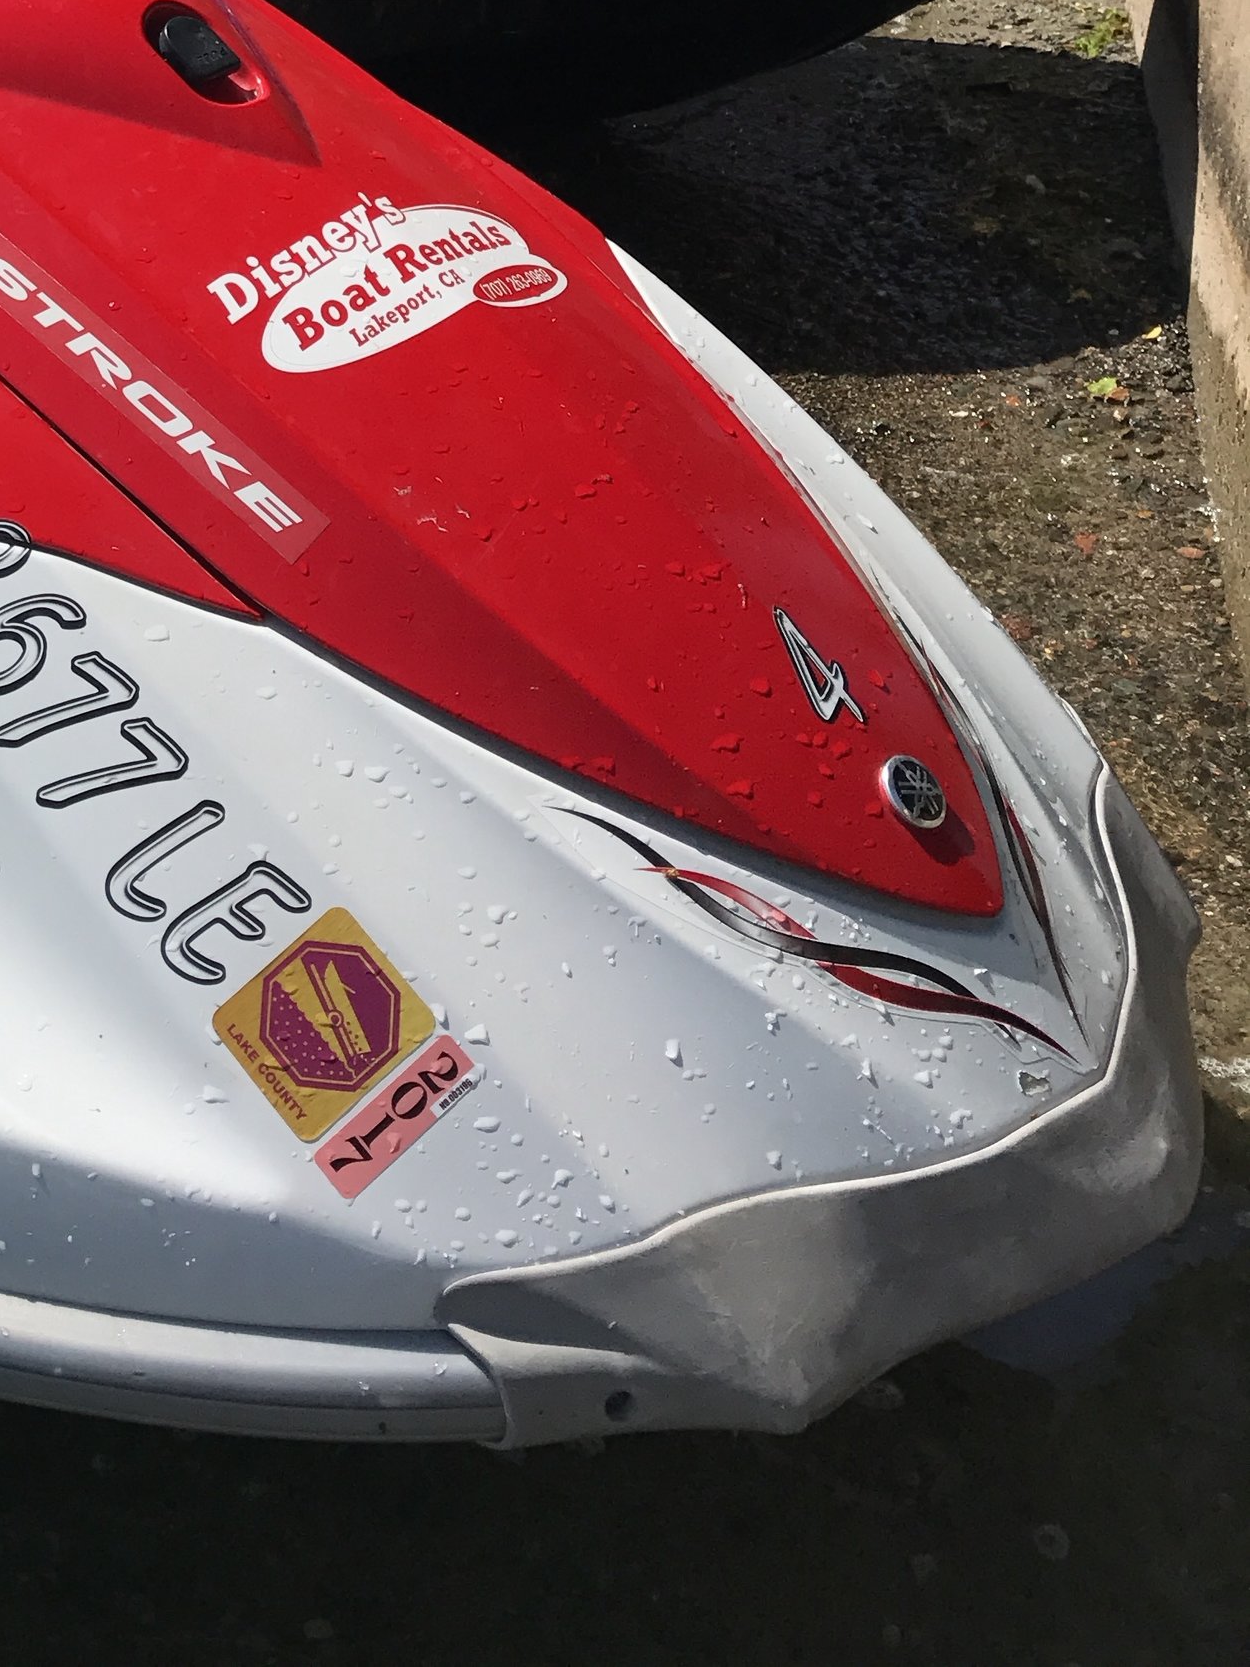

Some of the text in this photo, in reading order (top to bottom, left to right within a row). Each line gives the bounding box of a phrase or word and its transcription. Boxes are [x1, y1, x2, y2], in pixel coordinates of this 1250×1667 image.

[206, 191, 408, 326] Disney's
[281, 220, 512, 352] Boat Rentals
[347, 267, 464, 348] Lakeport, CA
[479, 277, 513, 301] (707)
[226, 1023, 308, 1121] LAKE COUNTY
[329, 1051, 460, 1173] 2017
